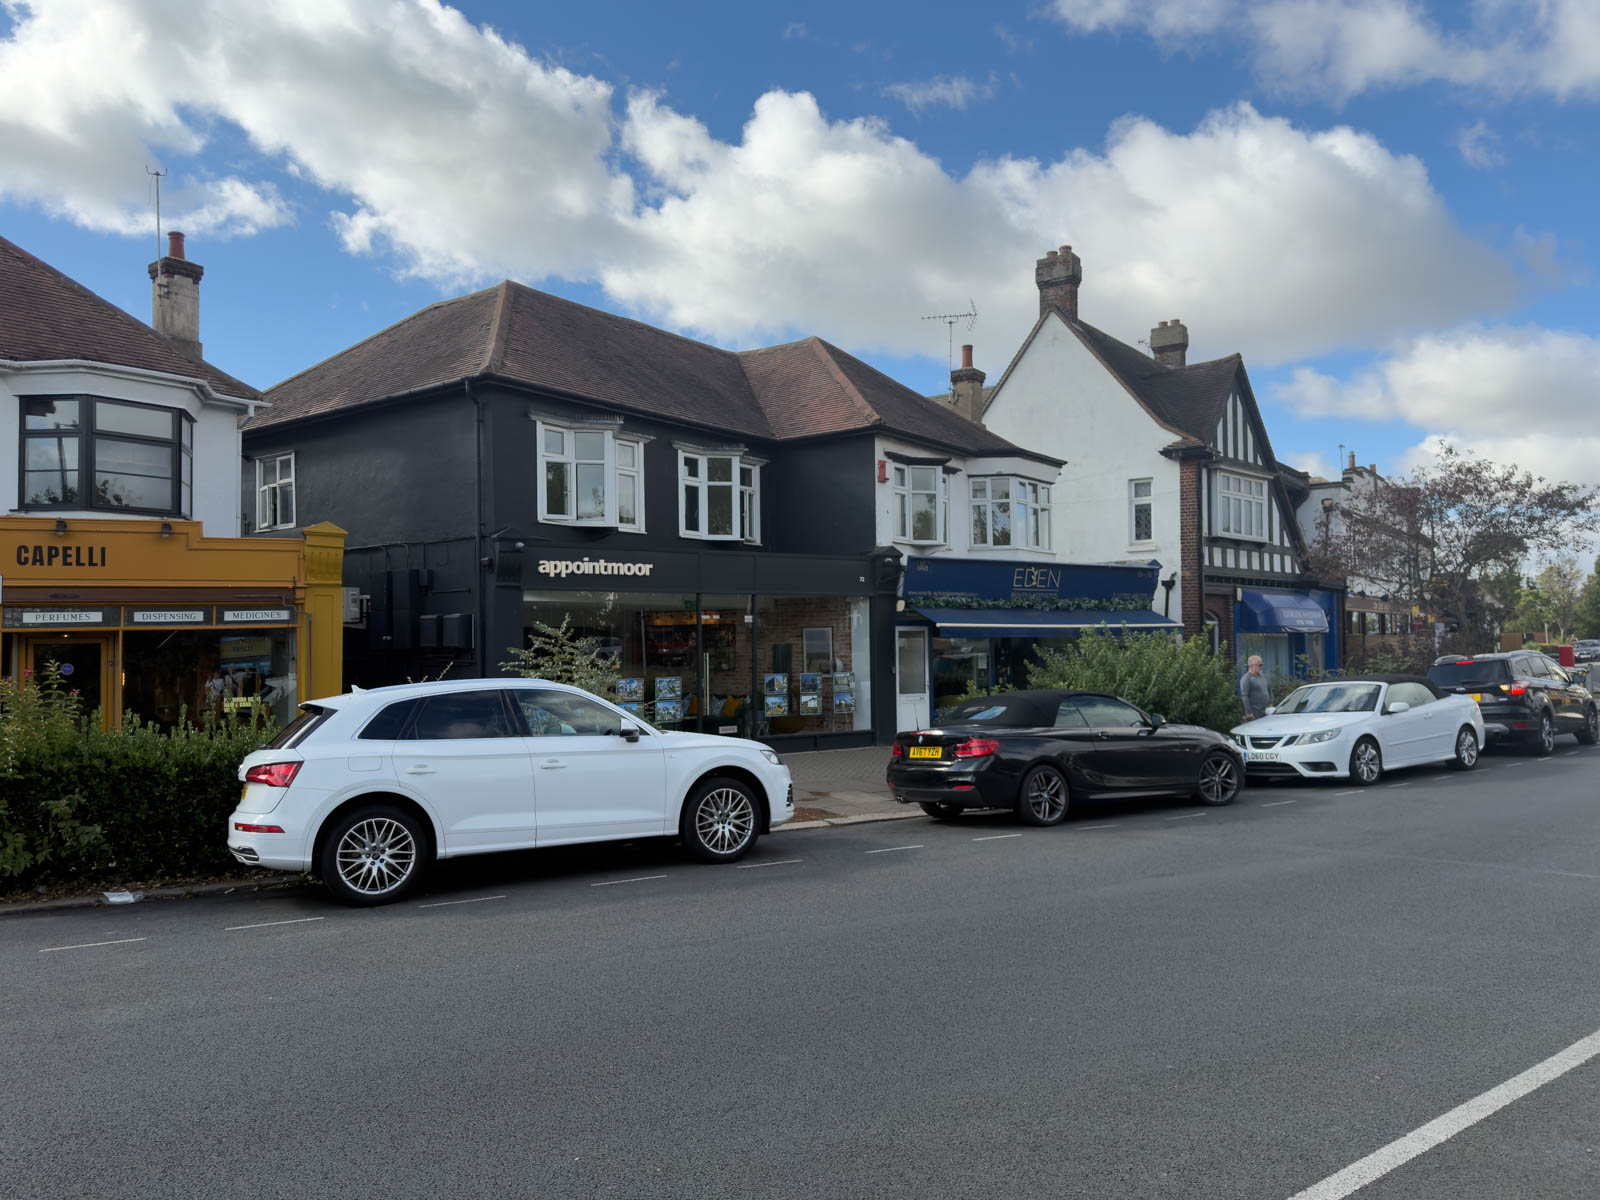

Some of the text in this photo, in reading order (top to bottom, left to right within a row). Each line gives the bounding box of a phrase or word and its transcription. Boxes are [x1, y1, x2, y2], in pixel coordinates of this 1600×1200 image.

[16, 545, 106, 567] CAPELLI
[538, 557, 653, 577] appointmoor
[1013, 567, 1061, 588] EDEN
[35, 612, 91, 622] PERFUMES
[142, 612, 196, 621] DISPENSING
[232, 611, 282, 620] MEDICINES
